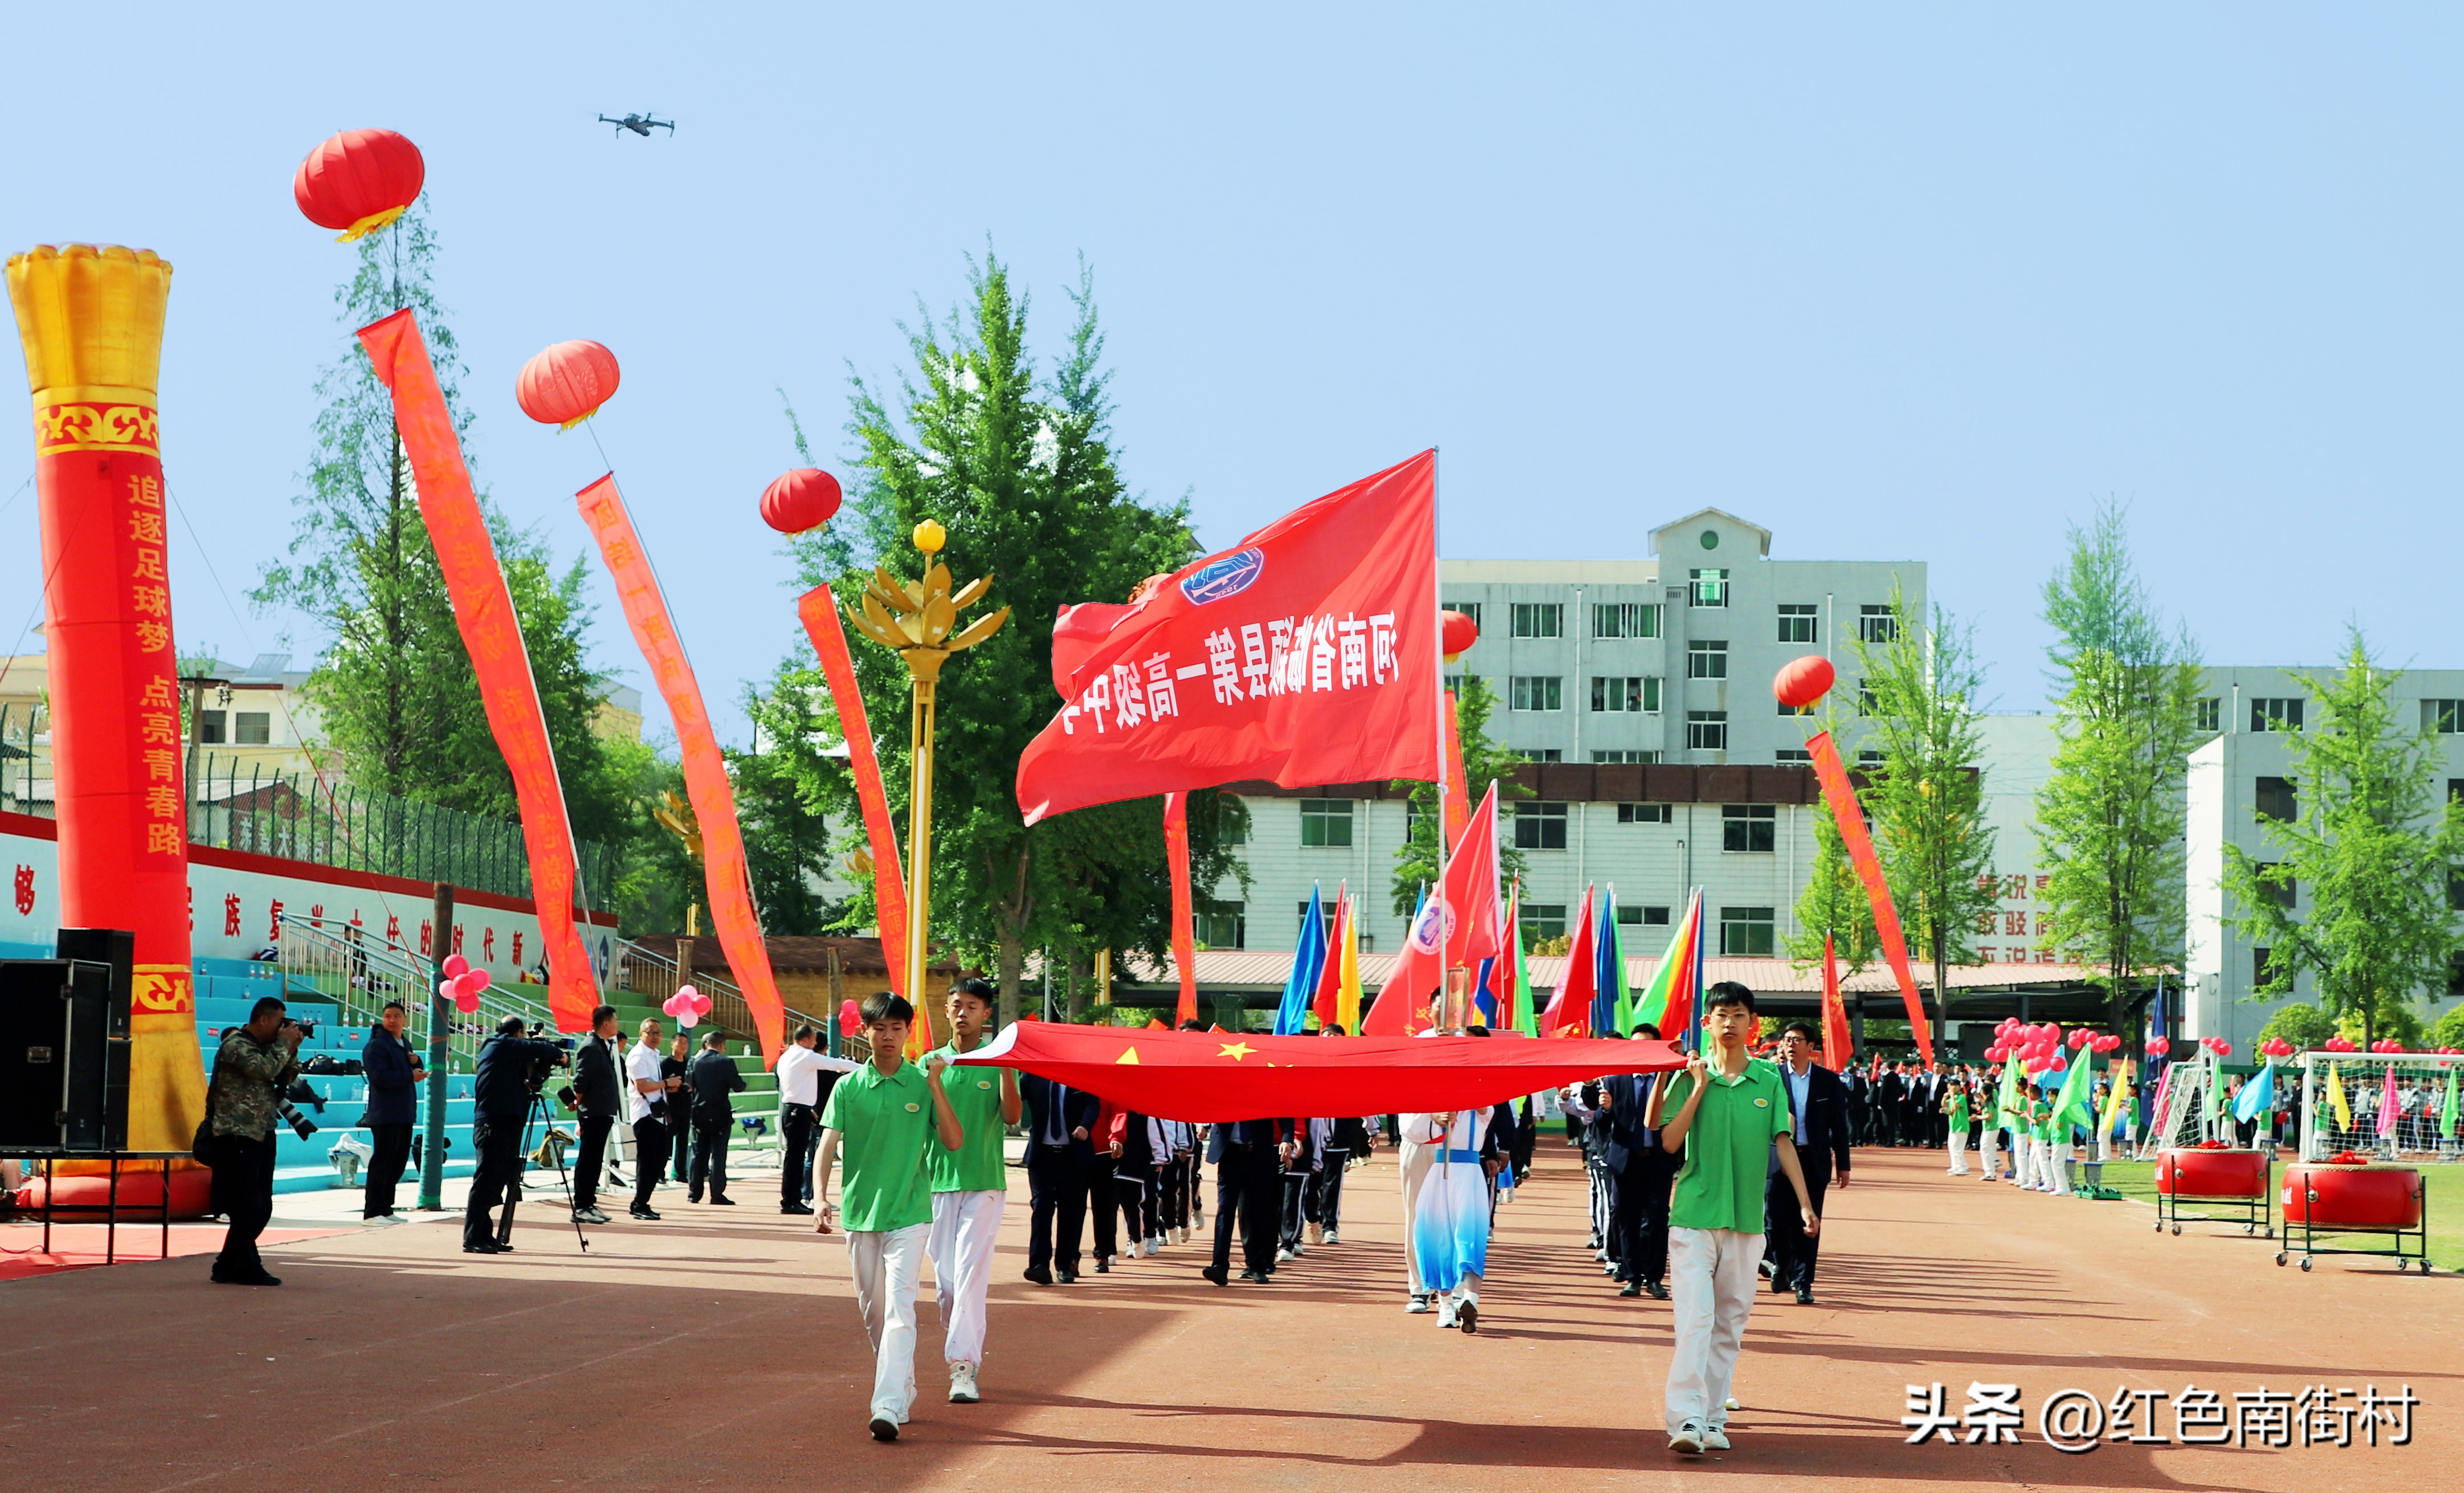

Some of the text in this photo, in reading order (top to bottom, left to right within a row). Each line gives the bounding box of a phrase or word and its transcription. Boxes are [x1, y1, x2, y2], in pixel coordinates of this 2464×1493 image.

[128, 474, 181, 856] 追逐足球梦 点亮青春路
[14, 863, 35, 916] 够
